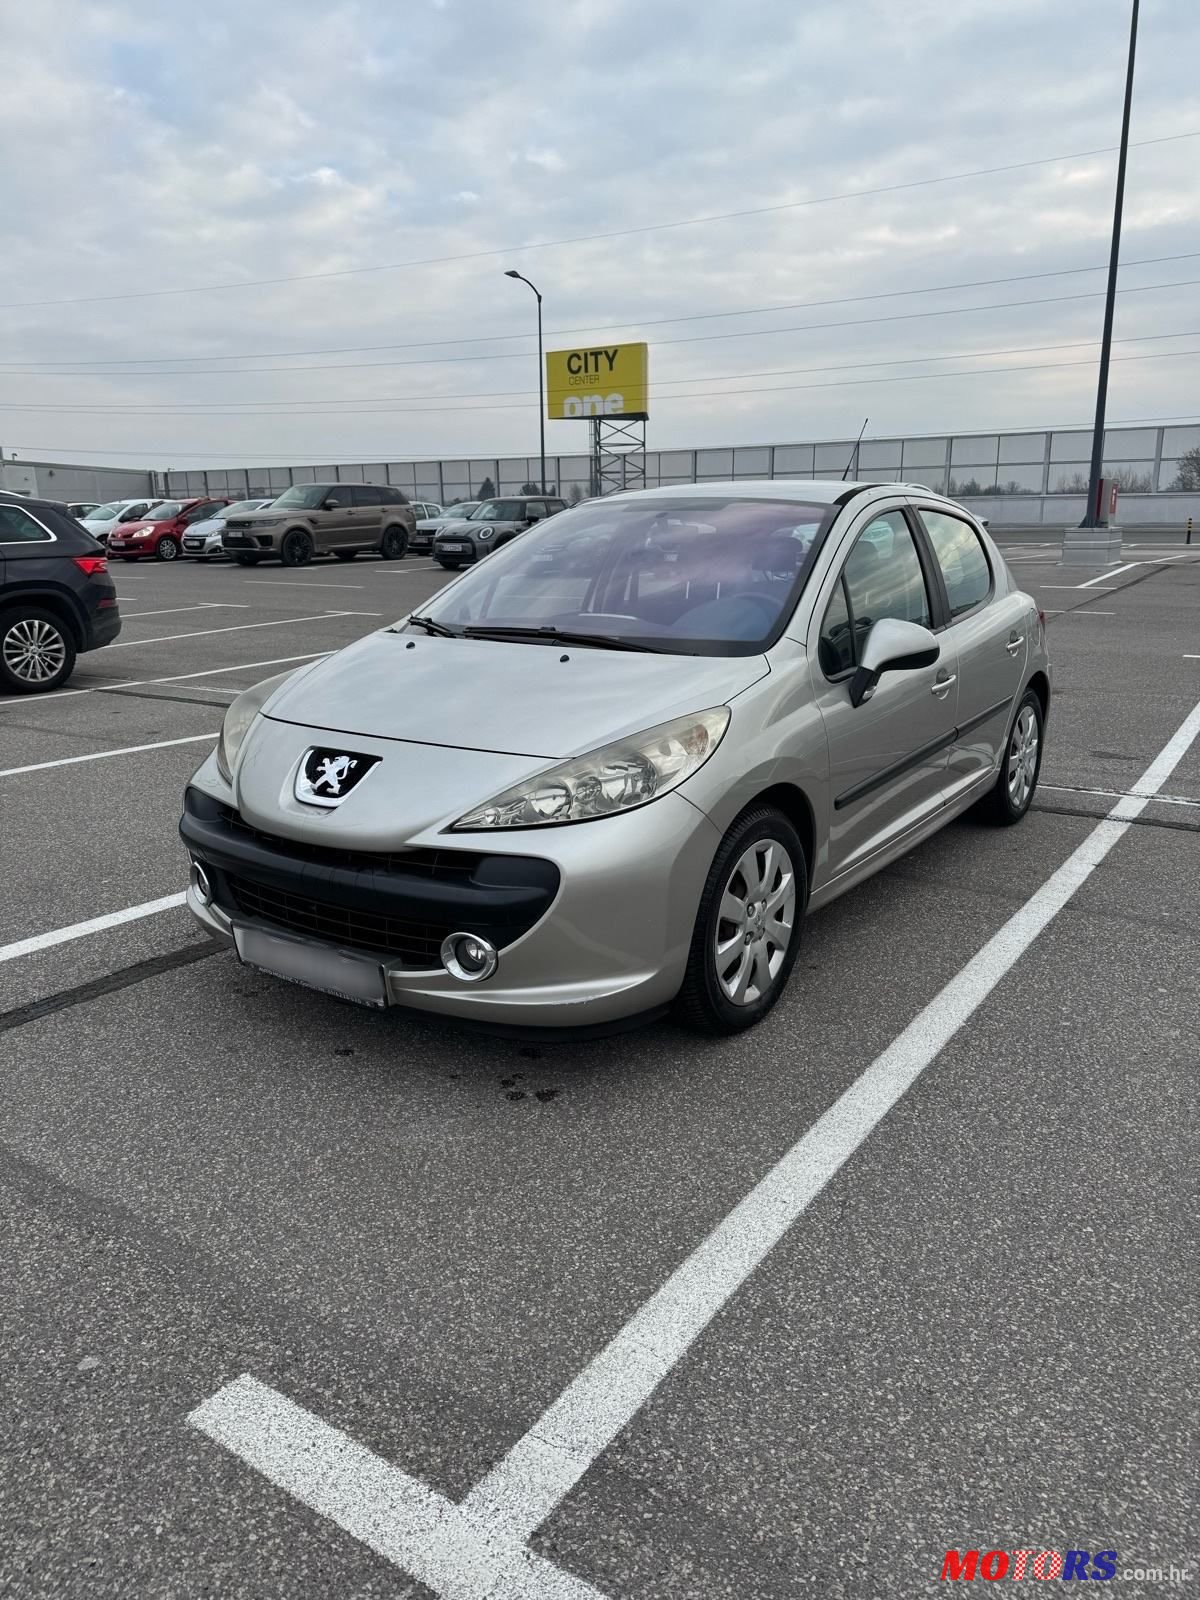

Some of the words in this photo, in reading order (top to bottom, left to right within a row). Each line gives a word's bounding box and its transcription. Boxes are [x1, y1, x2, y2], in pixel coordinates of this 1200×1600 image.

[567, 349, 618, 375] CITY
[568, 375, 600, 386] CENTER
[563, 393, 624, 417] one
